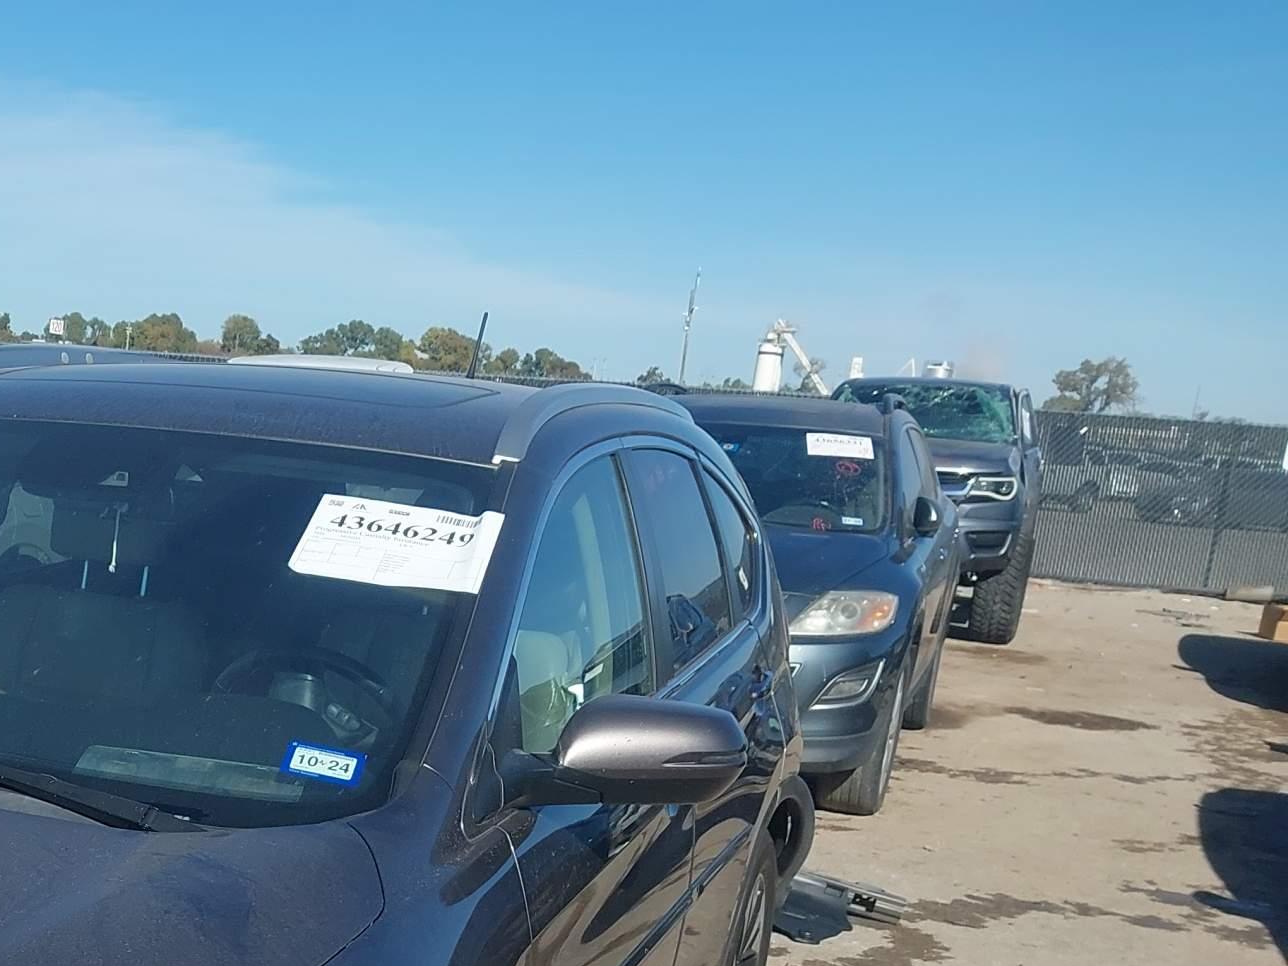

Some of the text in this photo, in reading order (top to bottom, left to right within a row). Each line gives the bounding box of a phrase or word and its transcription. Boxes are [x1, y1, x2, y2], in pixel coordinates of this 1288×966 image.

[330, 514, 475, 548] 43646249
[298, 754, 319, 767] 10
[327, 760, 351, 774] 24
